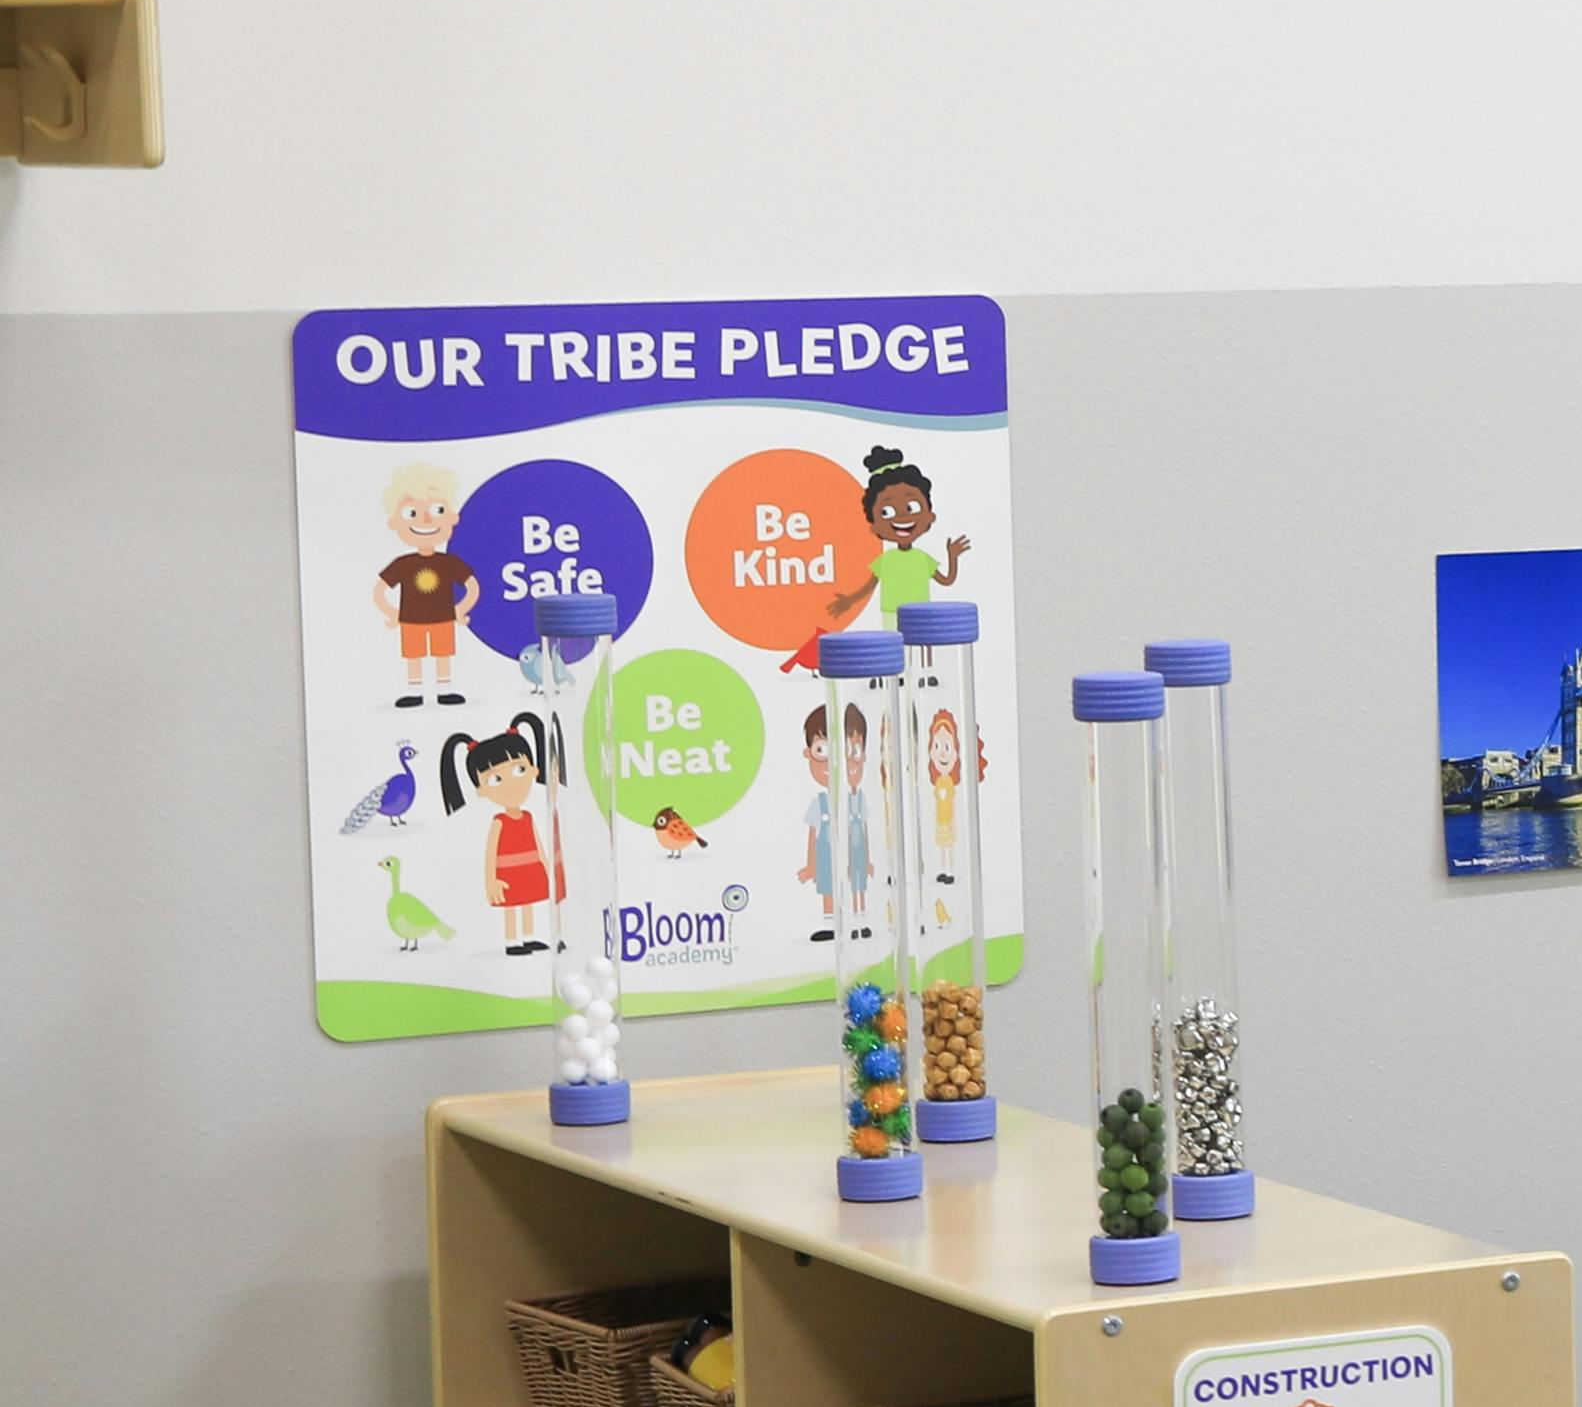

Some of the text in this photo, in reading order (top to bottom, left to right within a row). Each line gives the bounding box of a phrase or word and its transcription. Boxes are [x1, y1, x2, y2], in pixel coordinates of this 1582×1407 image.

[336, 322, 970, 390] OUR TRIBE PLEDGE
[522, 516, 580, 555] Be
[756, 504, 812, 542] Be
[501, 557, 604, 601] Safe
[733, 543, 836, 588] Kind
[645, 694, 702, 732] Be
[621, 738, 733, 779] Neat
[619, 901, 725, 962] Bloom
[645, 946, 735, 966] academy
[1194, 1354, 1434, 1403] CONSTRUCTION
